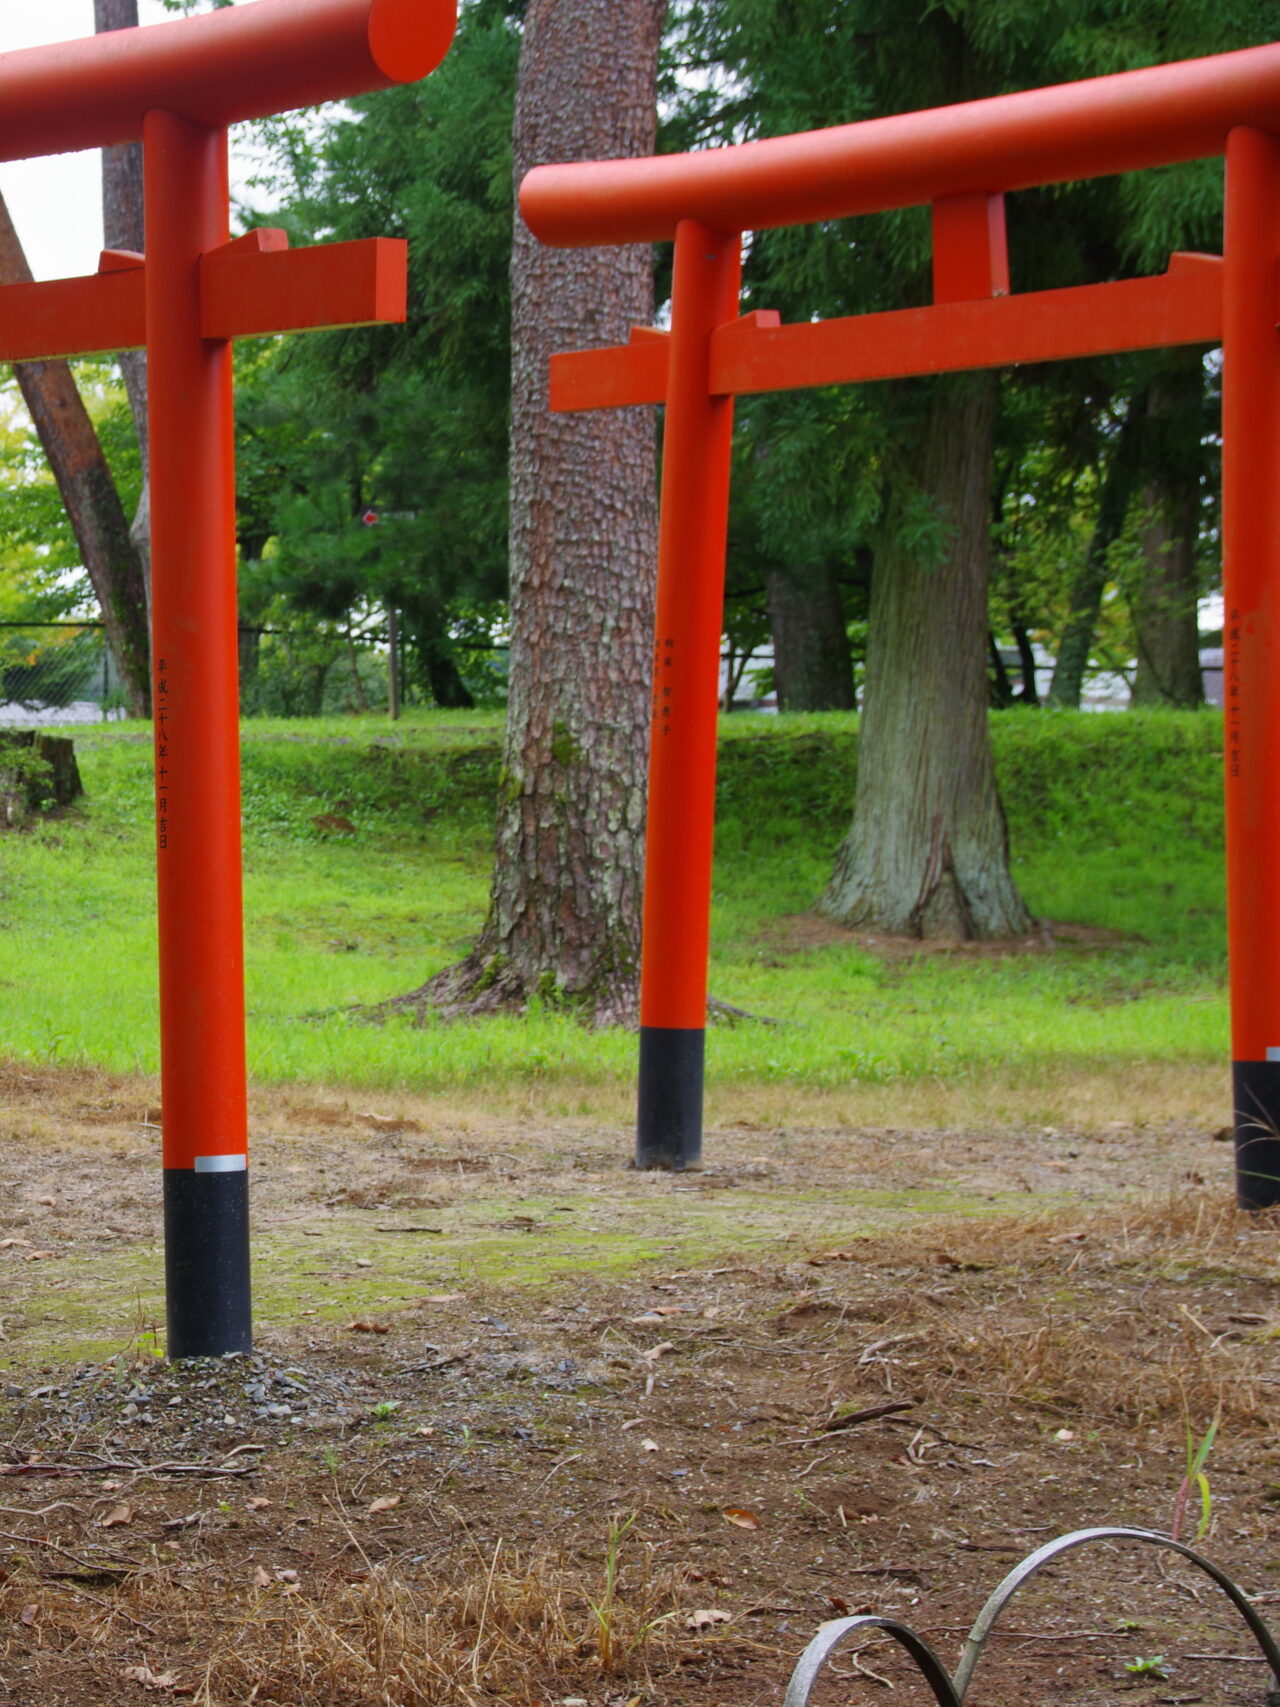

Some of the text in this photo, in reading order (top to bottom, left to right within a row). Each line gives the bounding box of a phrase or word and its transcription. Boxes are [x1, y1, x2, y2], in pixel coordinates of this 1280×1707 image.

[157, 659, 168, 849] 平成二十八年十一月吉日
